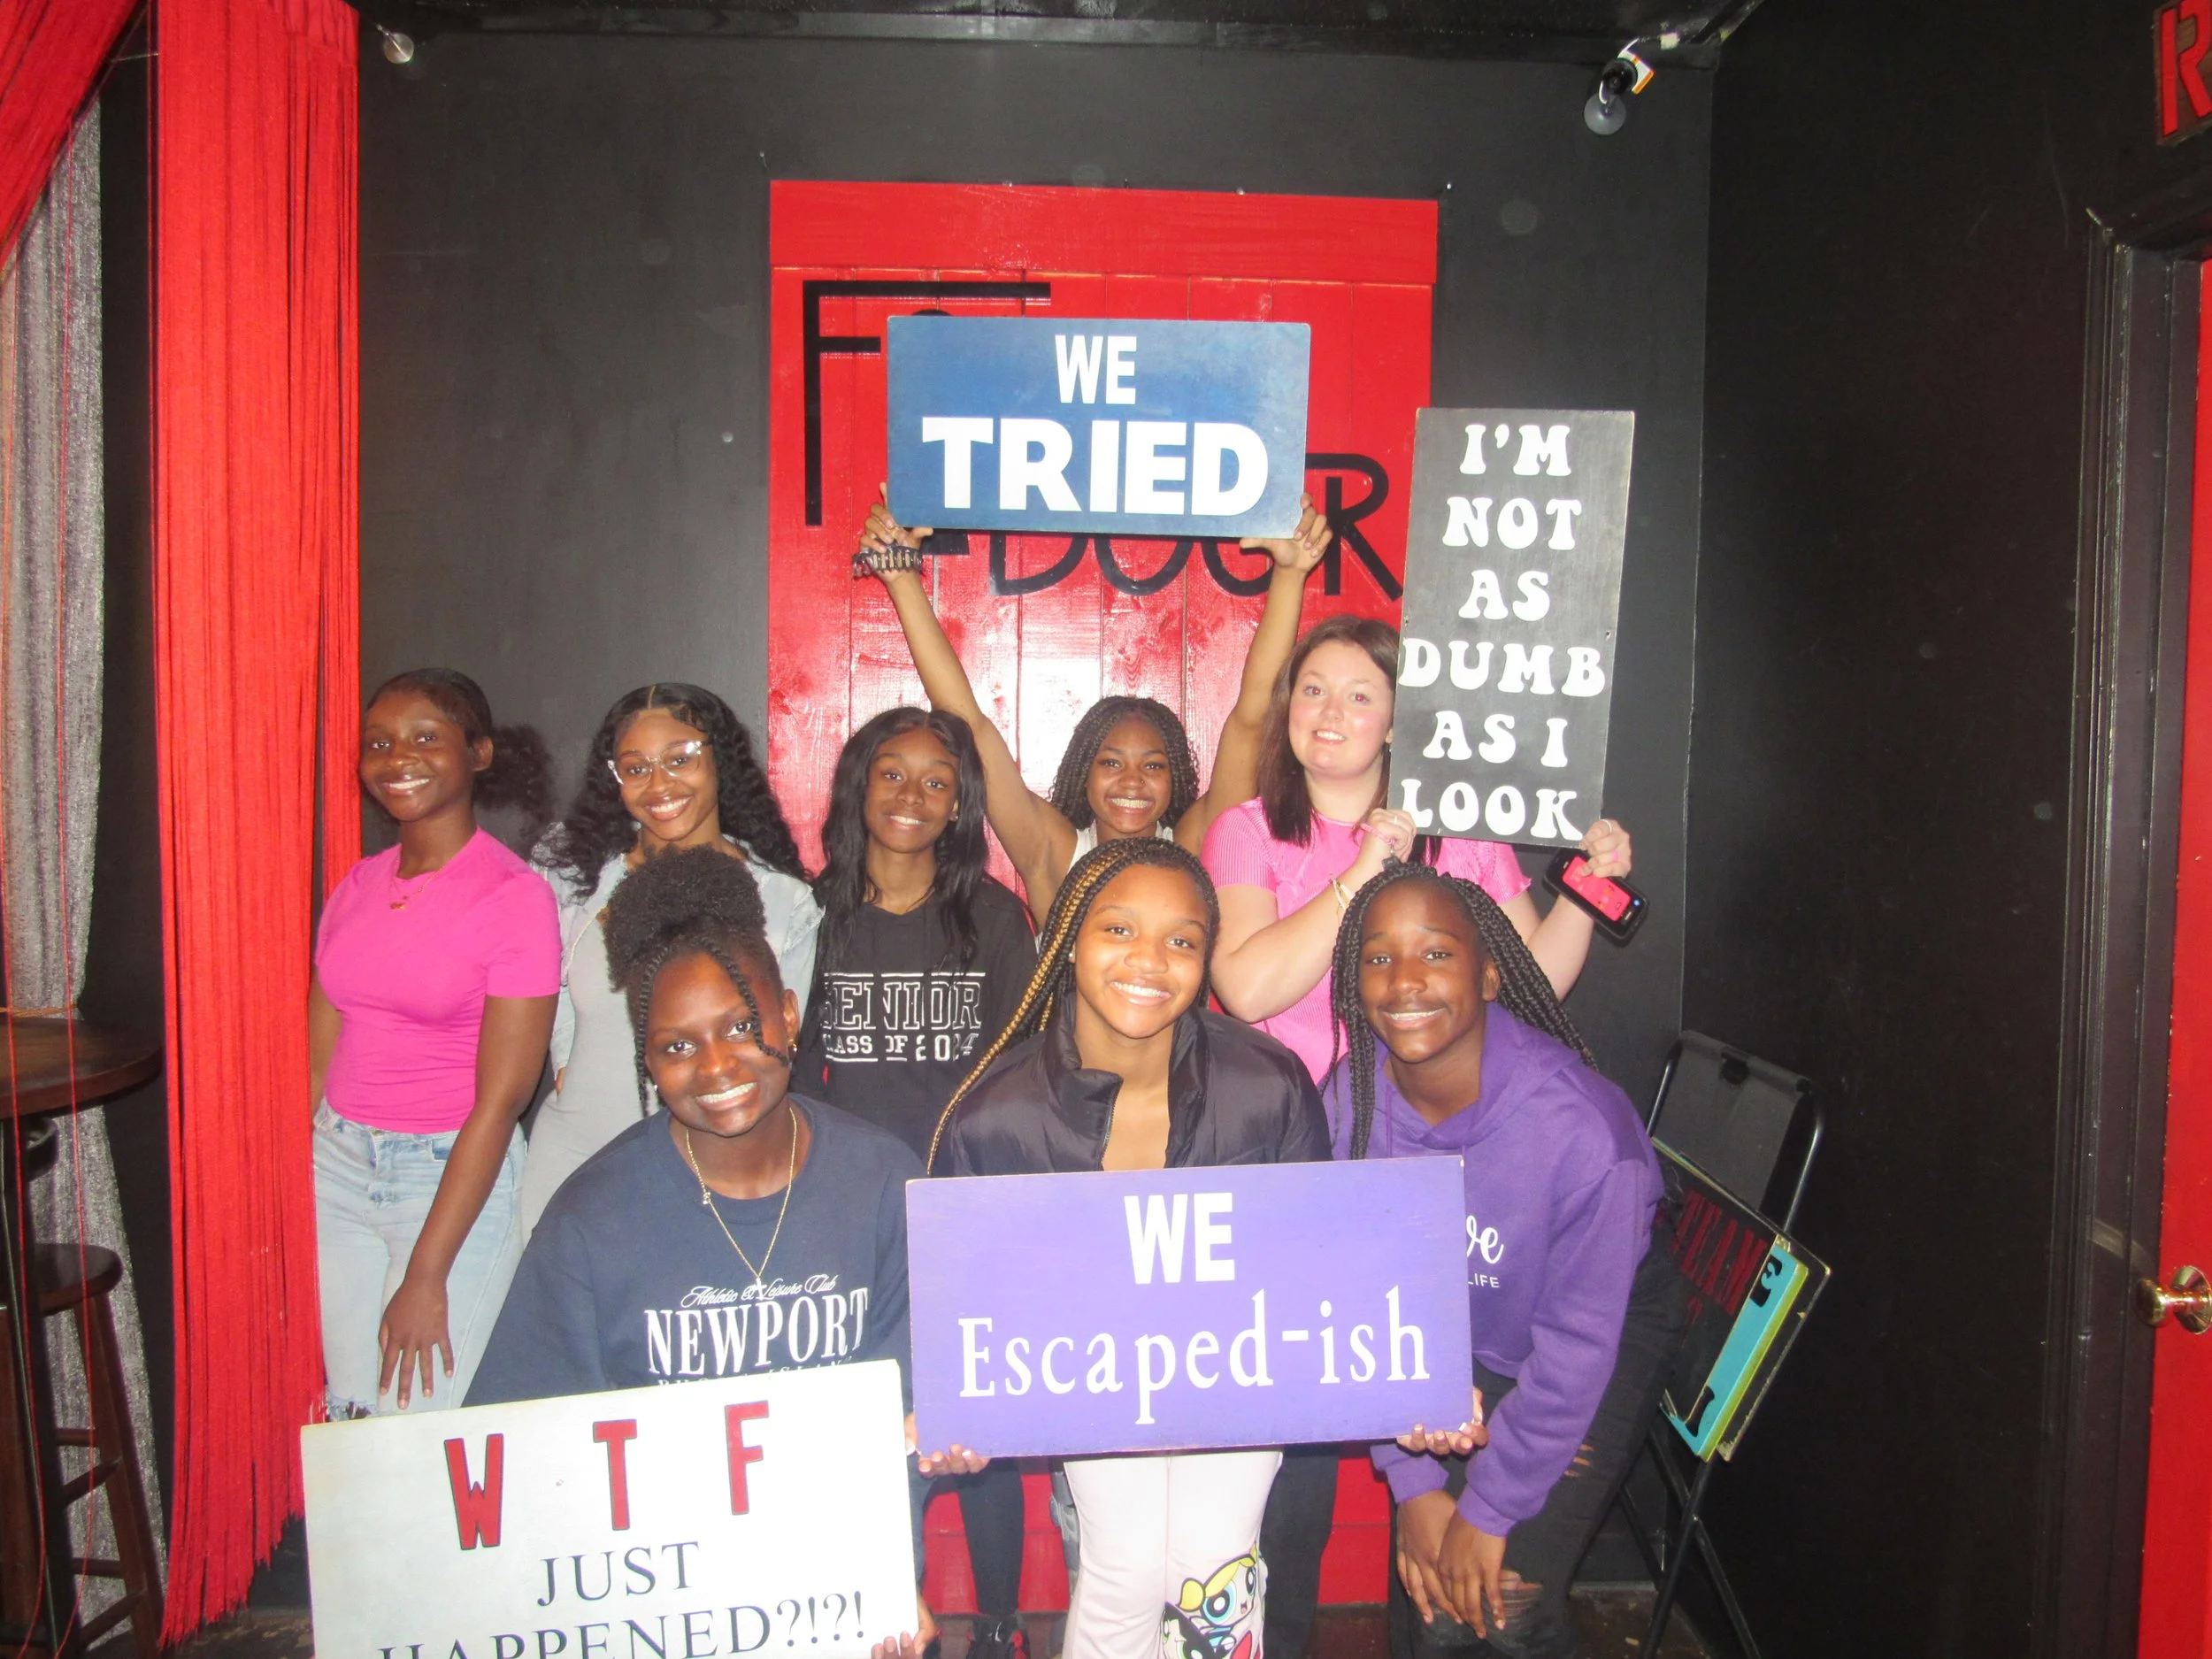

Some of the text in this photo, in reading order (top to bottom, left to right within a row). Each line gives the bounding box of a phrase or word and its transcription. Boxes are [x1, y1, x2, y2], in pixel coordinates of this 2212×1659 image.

[1054, 334, 1137, 404] WE
[922, 417, 1269, 516] TRIED
[1460, 424, 1571, 476] I'M
[1442, 496, 1582, 550] NOT
[1458, 569, 1550, 621] AS
[1399, 638, 1606, 697] DUMB
[1423, 710, 1568, 768] AS I
[1401, 779, 1583, 841] LOOK
[823, 1033, 873, 1054] LASS
[1124, 1192, 1235, 1285] WE
[680, 1286, 738, 1308] Athletic
[759, 1278, 803, 1301] Leisure
[804, 1273, 839, 1294] Club
[644, 1287, 868, 1376] NEWPORT
[958, 1286, 1430, 1425] Escaped-ish
[537, 1541, 699, 1607] JUST
[378, 1590, 864, 1659] PPENED?!?!
